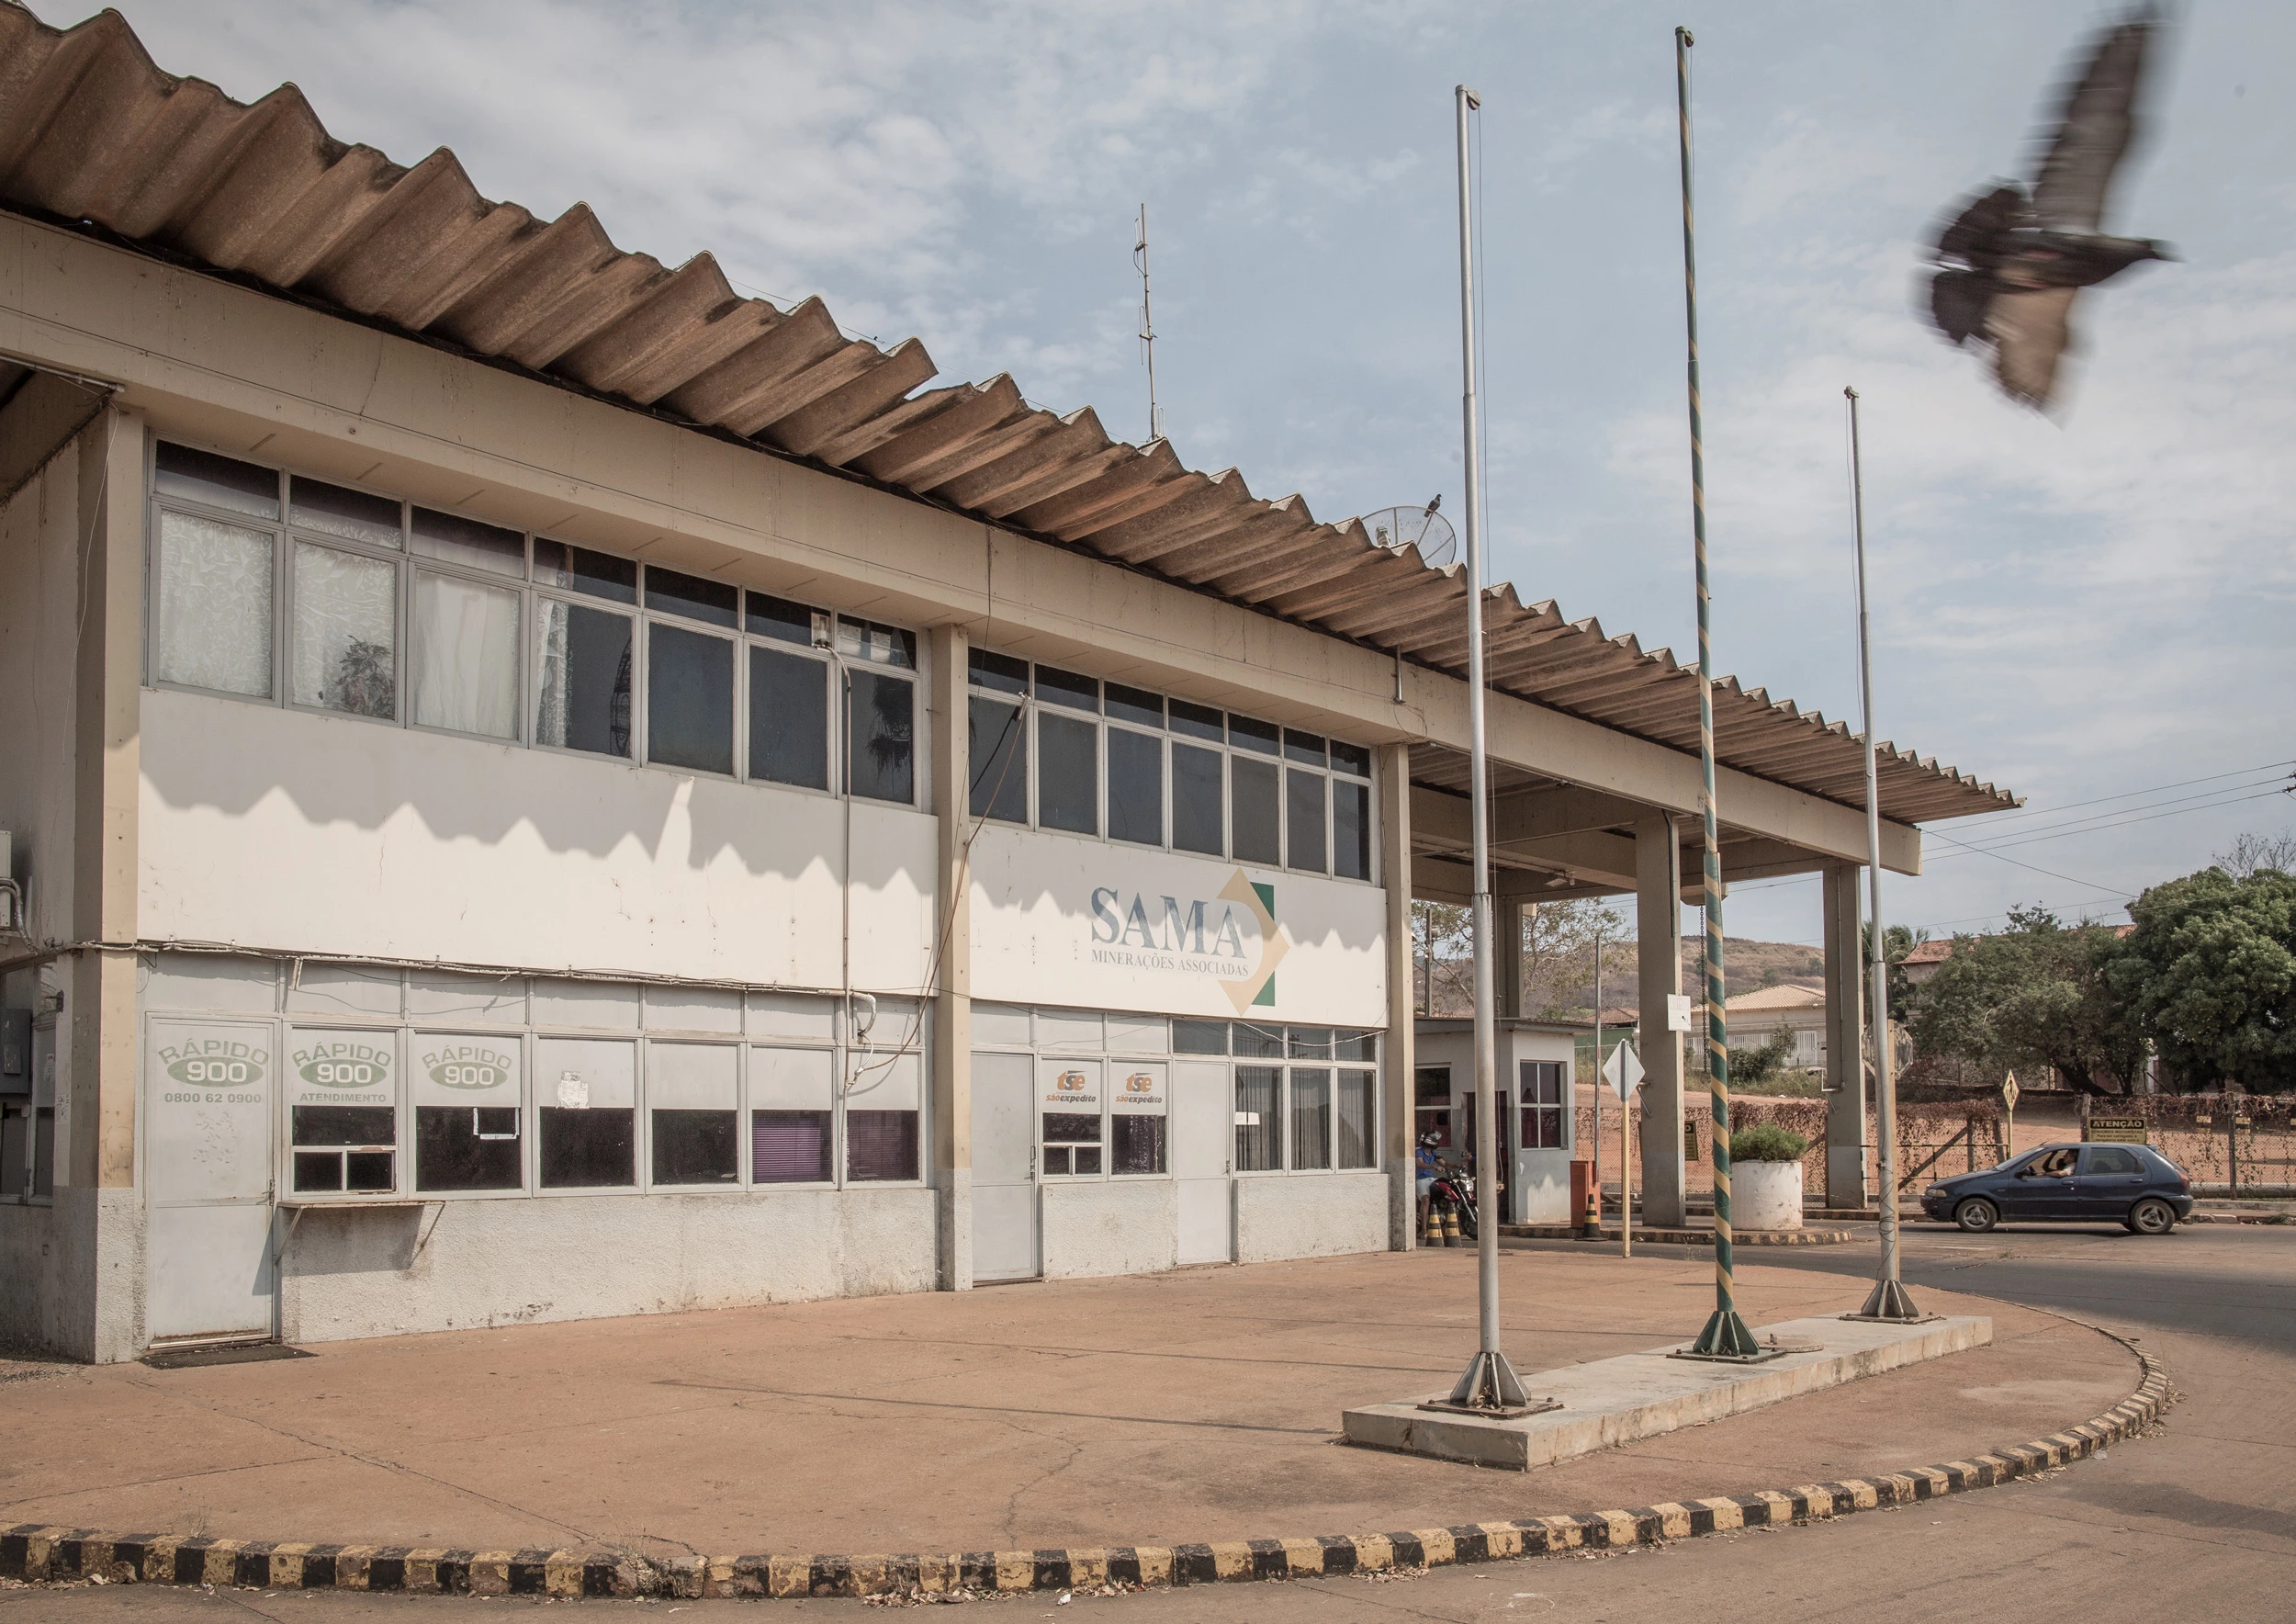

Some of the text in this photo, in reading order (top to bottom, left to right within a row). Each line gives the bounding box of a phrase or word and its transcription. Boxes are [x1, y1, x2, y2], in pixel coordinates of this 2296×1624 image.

[1091, 886, 1247, 959] SAMA
[1091, 949, 1249, 976] MINERAÇÕES ASSOCIADAS
[157, 1037, 269, 1066] RÁPIDO
[291, 1041, 392, 1068] RÁPIDO
[421, 1044, 512, 1070] RÁPIDO
[186, 1061, 247, 1083] 900
[317, 1063, 372, 1084] 900
[445, 1066, 495, 1086] 900
[164, 1092, 262, 1103] 0800 62 0900
[299, 1092, 387, 1103] ATENDIMENTO
